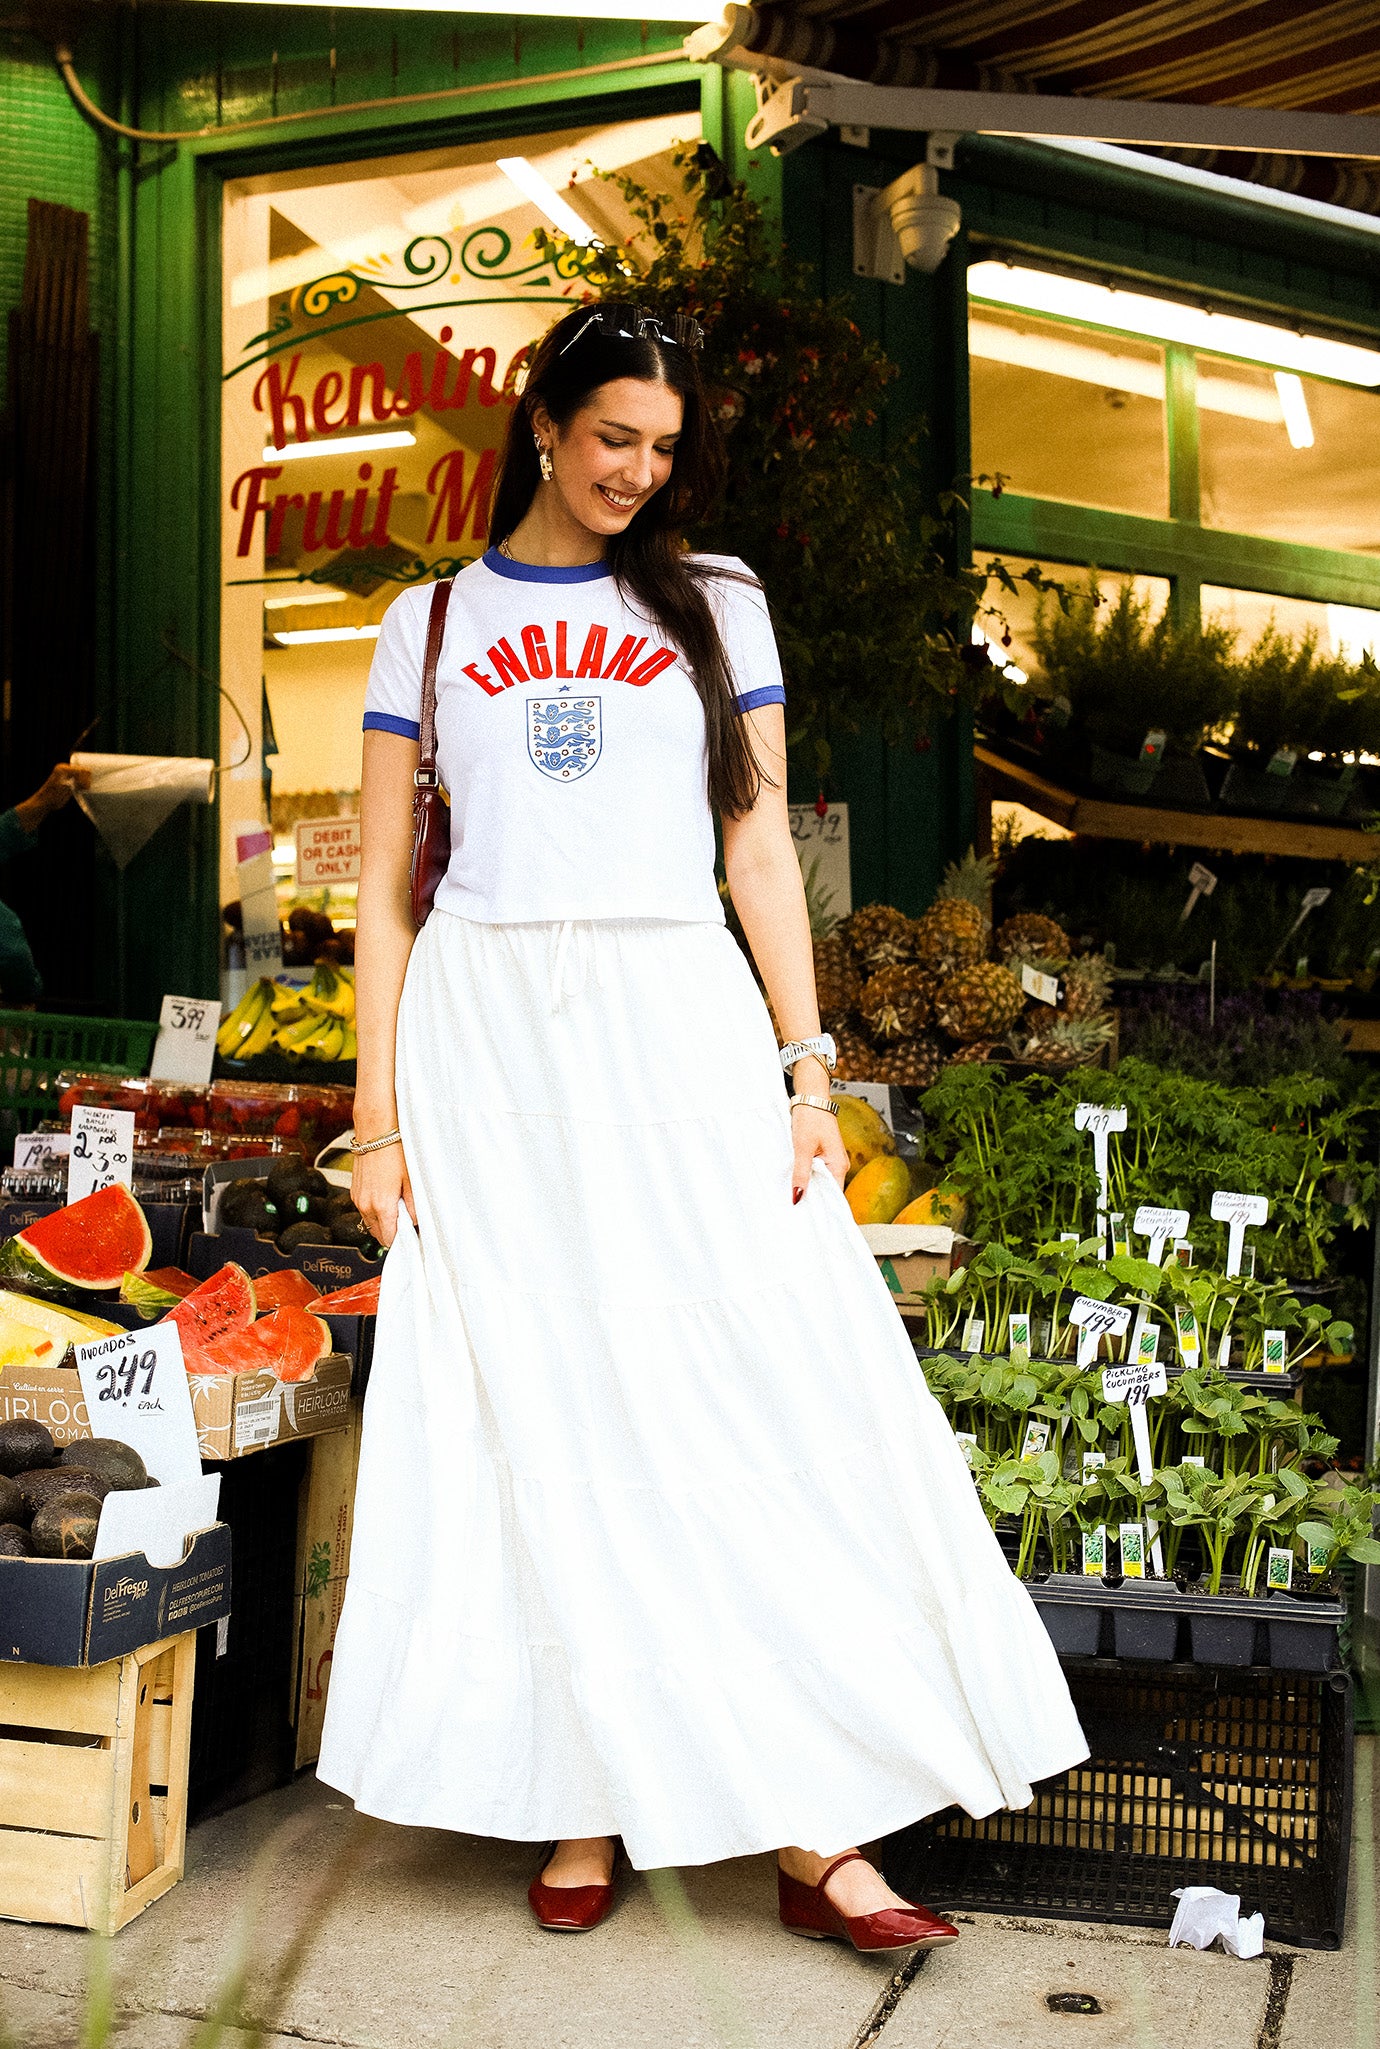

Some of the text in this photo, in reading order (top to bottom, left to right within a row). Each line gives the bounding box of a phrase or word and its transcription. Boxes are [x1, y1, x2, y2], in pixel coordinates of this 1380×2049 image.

[231, 463, 398, 557] Fruit
[461, 620, 678, 697] ENGLAND
[313, 829, 352, 844] DEBIT
[303, 847, 322, 861] OR
[315, 860, 352, 875] ONLY
[73, 1132, 118, 1159] 2 FOR
[303, 1259, 352, 1275] DelFresco
[1076, 1298, 1129, 1320] CUCUMBERS
[80, 1333, 136, 1361] AVOCADOS
[1106, 1371, 1160, 1388] CUCUMBERS
[297, 1389, 349, 1414] HEIRLOOM
[319, 1404, 347, 1418] TOMATOES
[104, 1577, 149, 1602] DelFresco
[12, 1646, 20, 1656] N
